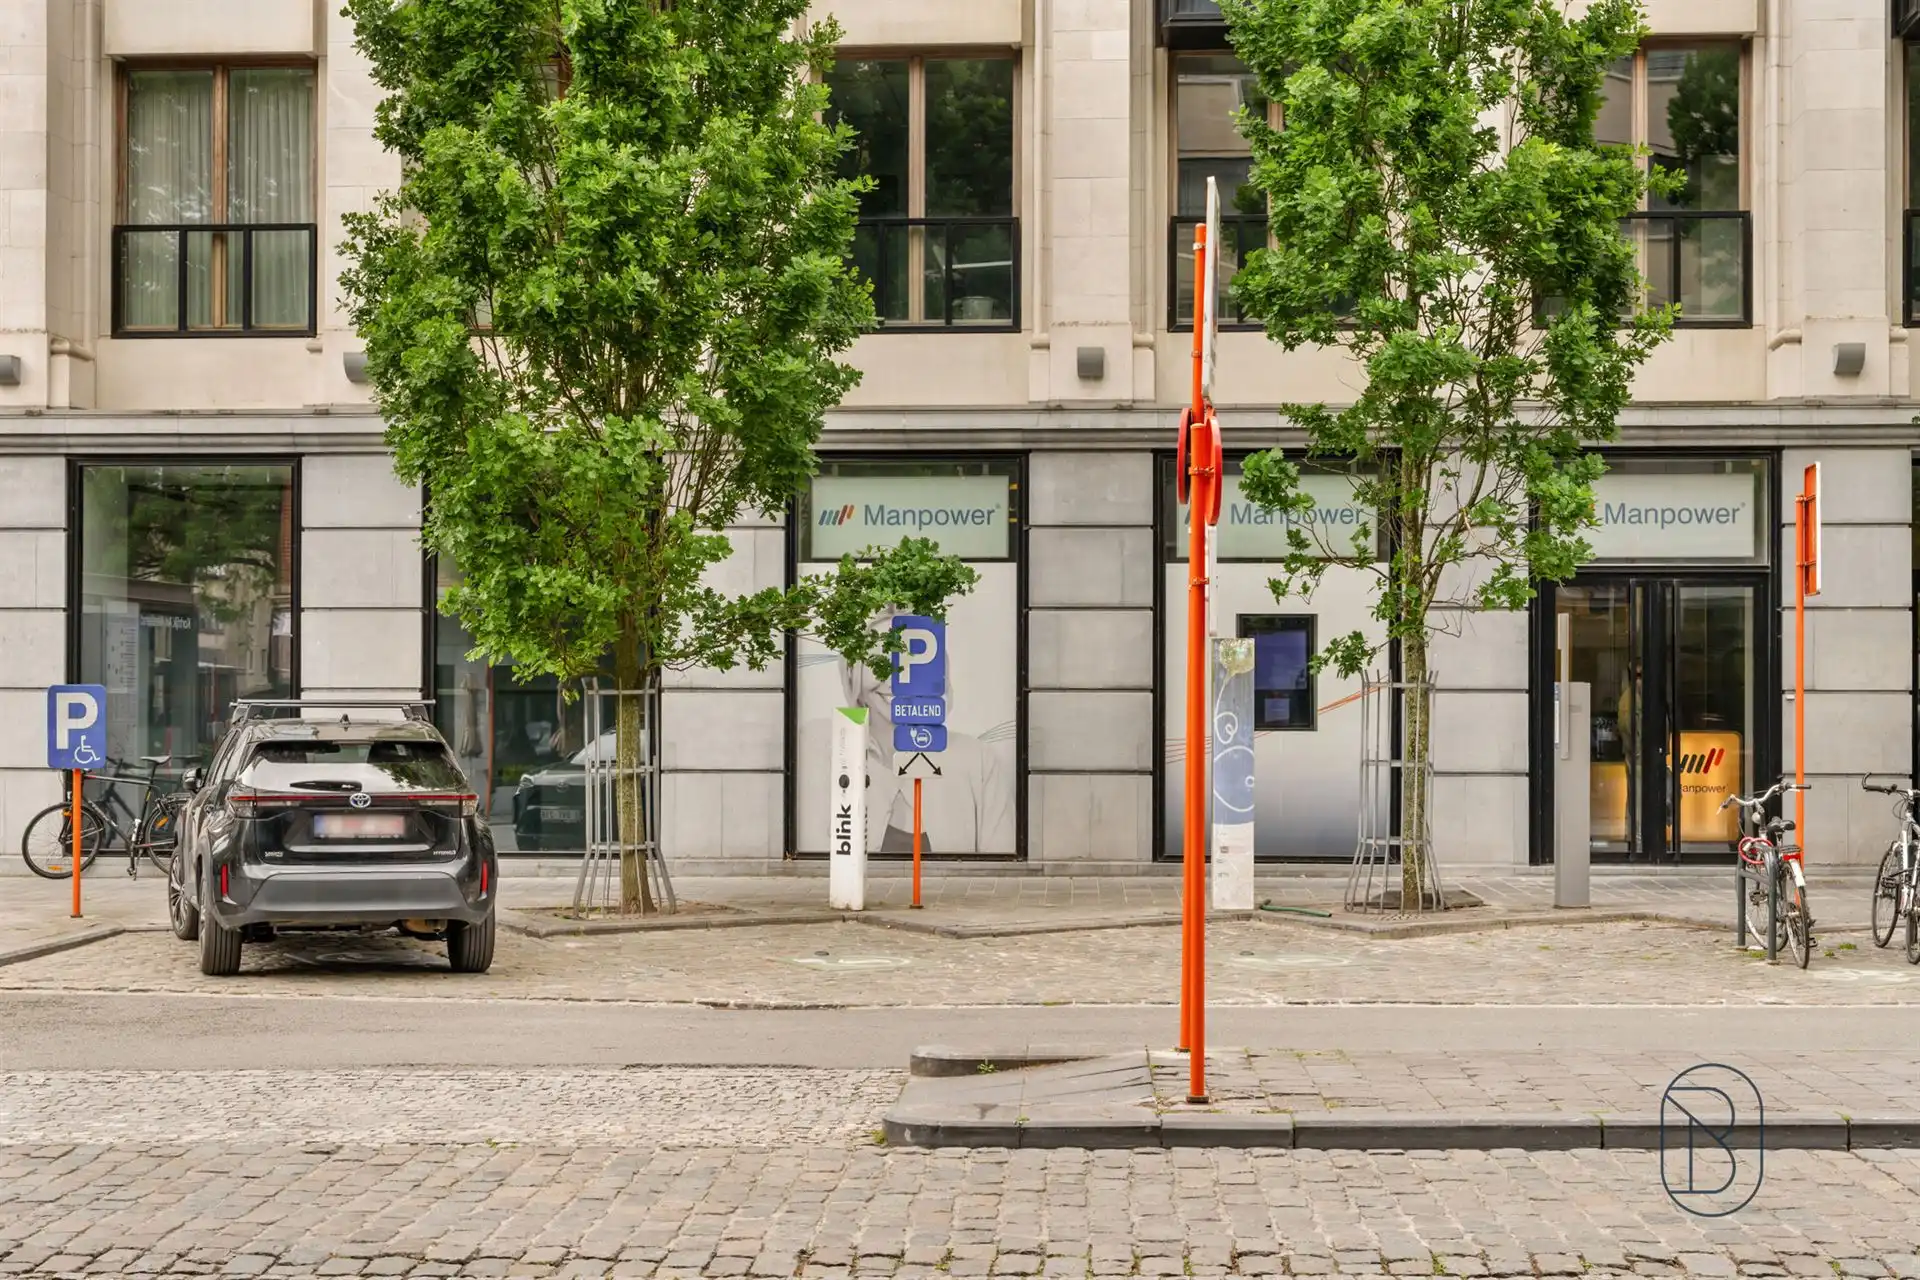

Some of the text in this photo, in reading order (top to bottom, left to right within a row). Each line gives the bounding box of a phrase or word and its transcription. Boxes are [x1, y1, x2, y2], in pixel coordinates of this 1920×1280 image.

[864, 504, 995, 531] Manpower
[1604, 503, 1740, 529] Manpower
[899, 629, 938, 684] P
[56, 692, 98, 749] P
[895, 704, 941, 717] BETALEND
[1681, 784, 1726, 794] anpower
[836, 804, 851, 855] blink
